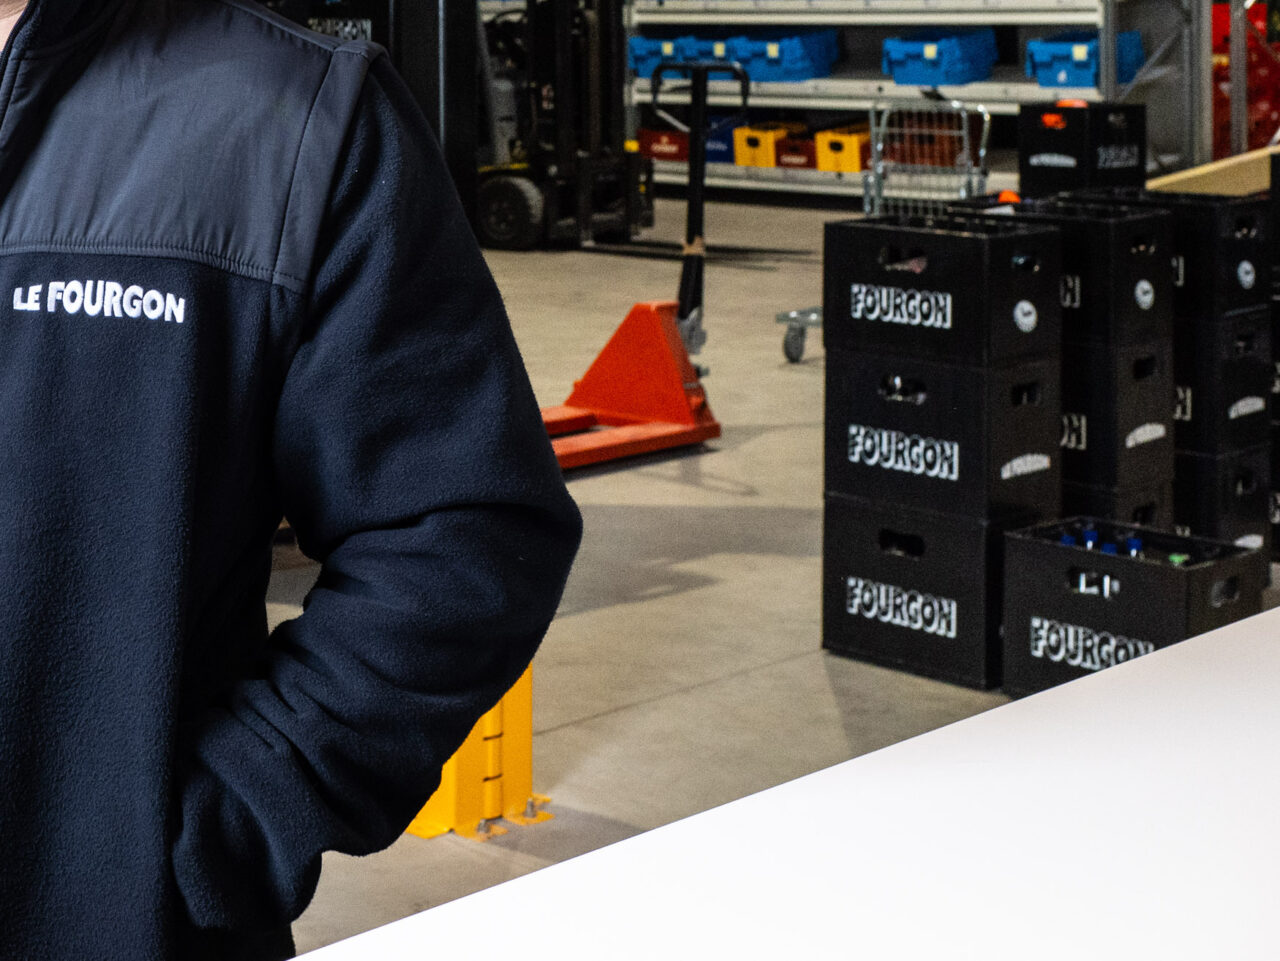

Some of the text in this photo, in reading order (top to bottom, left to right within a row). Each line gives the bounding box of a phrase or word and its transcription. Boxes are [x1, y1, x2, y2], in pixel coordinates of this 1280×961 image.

[13, 279, 185, 324] LE FOURGON
[851, 283, 952, 330] FOURGON
[848, 424, 959, 481] FOURGON
[847, 577, 957, 639] FOURGON
